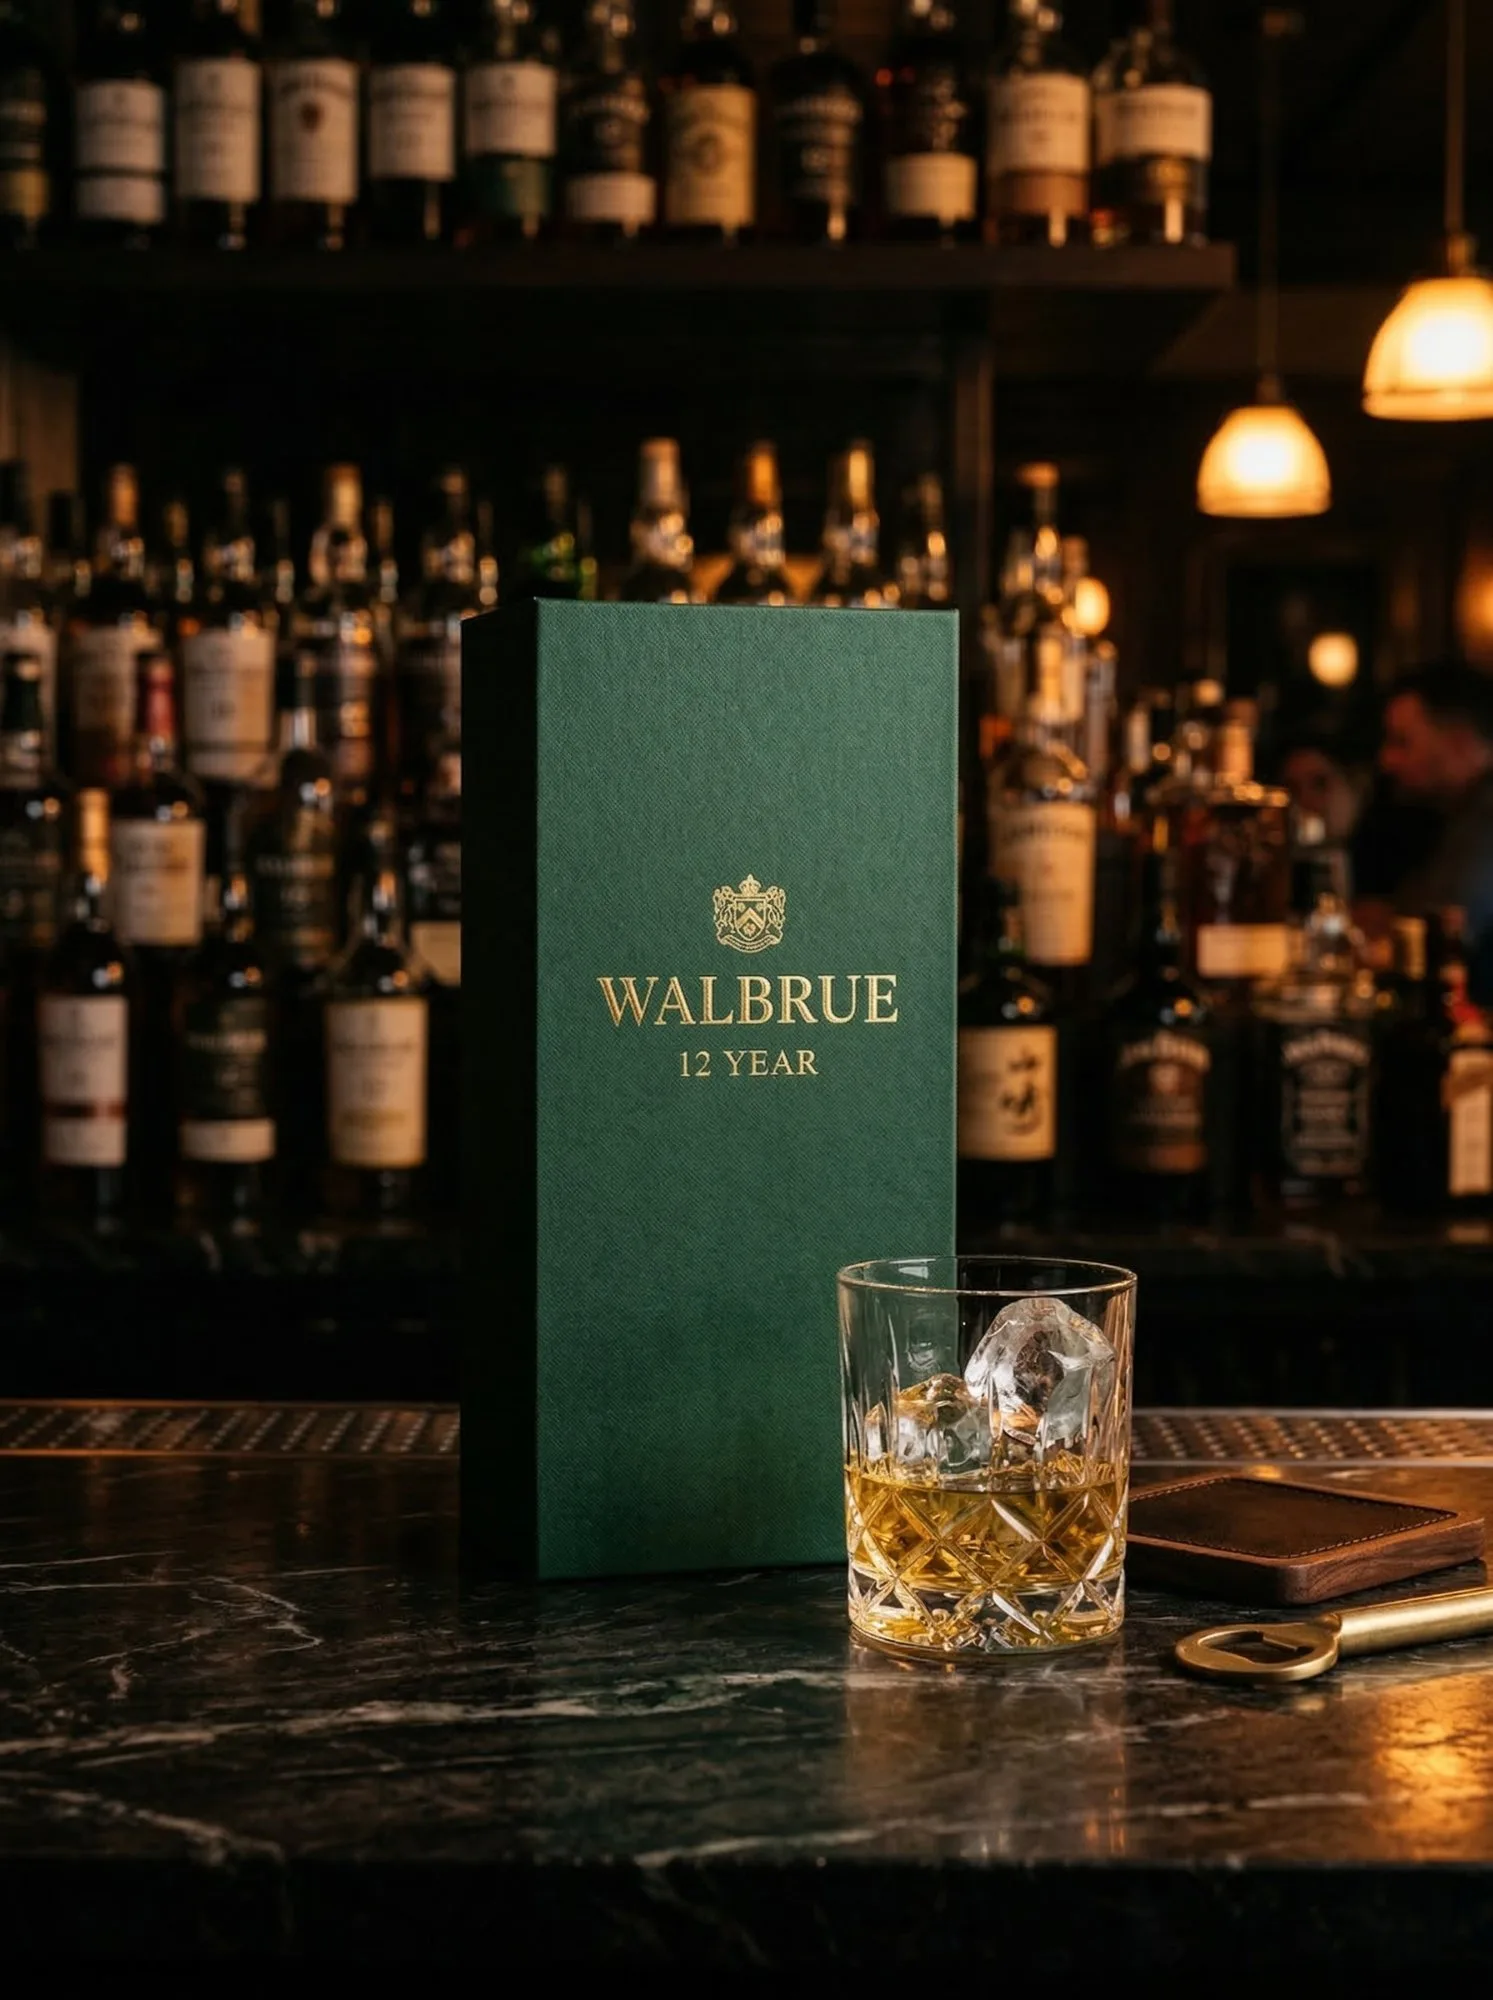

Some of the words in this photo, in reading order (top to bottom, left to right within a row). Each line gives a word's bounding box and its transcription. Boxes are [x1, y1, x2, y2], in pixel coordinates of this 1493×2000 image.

[597, 974, 899, 1026] WALBRUE
[680, 1051, 711, 1077] 12
[723, 1050, 819, 1077] YEAR
